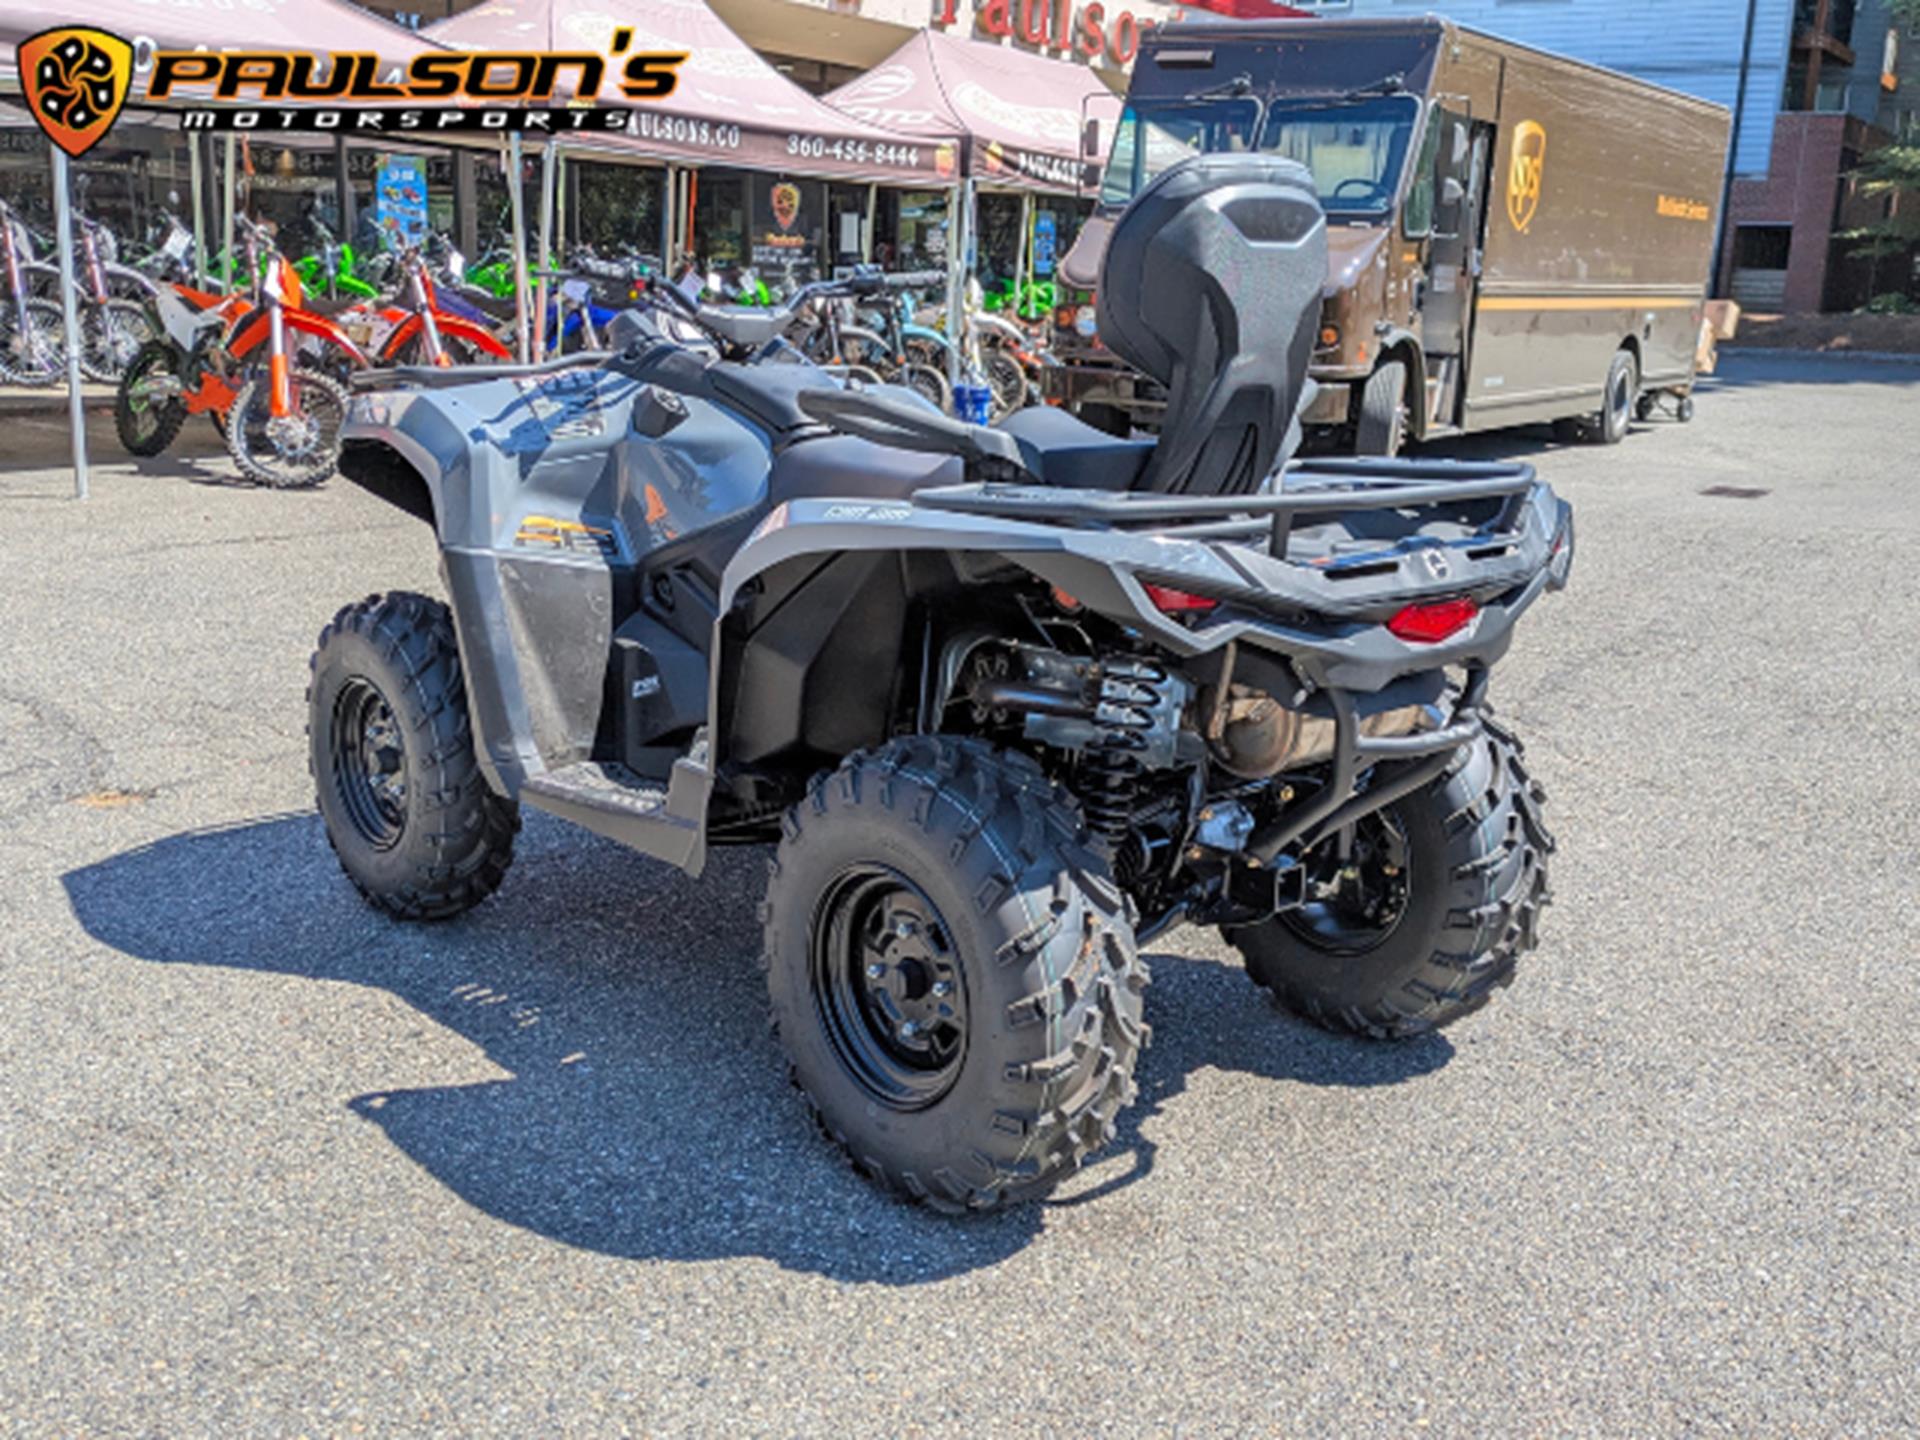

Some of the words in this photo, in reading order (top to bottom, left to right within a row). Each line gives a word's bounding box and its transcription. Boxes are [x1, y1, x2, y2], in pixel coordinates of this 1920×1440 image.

[940, 0, 1155, 63] aulso
[623, 110, 740, 149] AULSONS.CO
[785, 134, 919, 168] 360-456-8444
